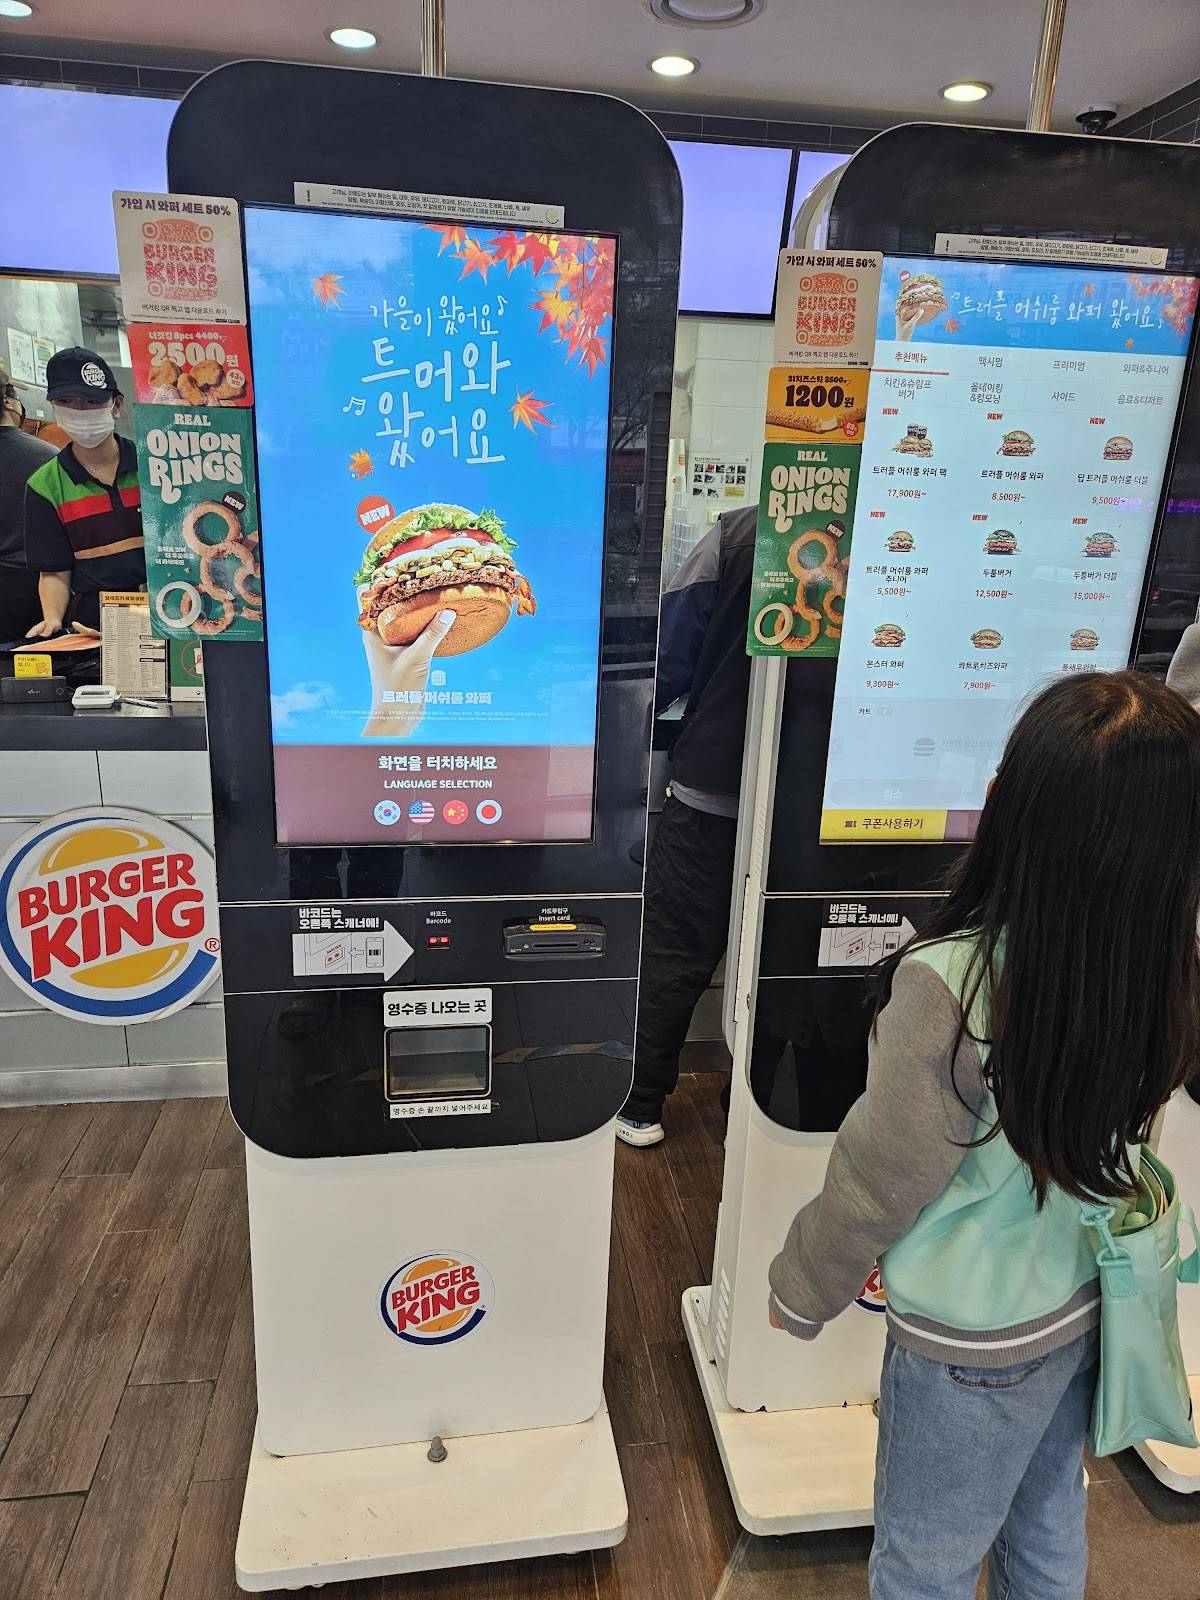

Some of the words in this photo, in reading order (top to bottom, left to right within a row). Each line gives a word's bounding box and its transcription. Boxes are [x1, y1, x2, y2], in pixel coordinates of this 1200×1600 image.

[120, 198, 143, 210] 가입
[145, 199, 157, 211] 시
[158, 200, 180, 213] 와퍼
[182, 202, 204, 214] 세트
[206, 206, 231, 217] 50%
[143, 244, 216, 264] BURGER
[786, 255, 804, 267] 가입
[806, 256, 816, 267] 시
[816, 257, 835, 268] 와퍼
[836, 257, 855, 268] 세트
[855, 258, 877, 268] 50%
[145, 262, 218, 288] KING
[797, 296, 857, 312] BURGER
[958, 289, 1007, 321] 트러플
[1015, 295, 1060, 326] 머쉬룸
[1067, 301, 1101, 321] 와퍼
[1109, 298, 1154, 330] 왔어요
[370, 295, 431, 336] 가을이
[438, 295, 499, 336] 왔어요
[796, 312, 856, 334] KING
[148, 342, 239, 368] 2500원
[895, 351, 928, 363] 추천메뉴
[978, 356, 1003, 368] 맥시멈
[1052, 360, 1086, 372] 프리미엄
[361, 337, 512, 402] 트머와
[1123, 364, 1169, 376] 와퍼&주니어
[884, 377, 932, 389] 치킨&슈림프
[970, 382, 1003, 393] 올데이킹
[785, 384, 855, 408] 1200원
[898, 389, 915, 400] 버거
[970, 393, 1001, 404] &킹모닝
[1051, 391, 1077, 402] 사이드
[1117, 394, 1164, 406] 음료&디저트
[882, 408, 899, 416] NEW
[987, 413, 1003, 421] NEW
[174, 412, 212, 427] REAL
[1089, 417, 1106, 425] NEW
[376, 391, 506, 469] 왔어요
[146, 429, 242, 458] ONION
[796, 450, 828, 462] REAL
[148, 452, 244, 504] RINGS
[872, 466, 896, 476] 트러플
[897, 467, 921, 477] 머쉬룸
[922, 467, 937, 477] 와퍼
[980, 470, 1003, 480] 트러플
[1005, 471, 1027, 481] 머쉬룸
[1029, 472, 1044, 481] 와퍼
[770, 465, 851, 492] ONION
[223, 494, 245, 512] NEW
[768, 485, 849, 533] RINGS
[359, 504, 391, 527] NEW
[1072, 517, 1088, 525] NEW
[826, 522, 844, 538] NEW
[914, 567, 929, 577] 와퍼
[885, 575, 907, 584] 주니어
[866, 660, 888, 669] 몬스터
[890, 660, 905, 669] 와퍼
[382, 690, 422, 704] 트러플
[466, 691, 492, 705] 와퍼
[378, 755, 422, 771] 화면을
[427, 755, 498, 771] 터치하세요
[384, 779, 438, 789] LANGUAGE
[439, 779, 493, 789] SELECTION
[862, 818, 924, 830] 쿠폰사용하기
[18, 853, 197, 929] BURGER
[299, 907, 342, 919] 바코드는
[829, 903, 867, 914] 바코드는
[300, 918, 331, 930] 오른쪽
[334, 917, 380, 929] 스캐너에!
[425, 917, 452, 925] Barcode
[538, 914, 556, 922] Insert
[828, 913, 857, 924] 오른쪽
[858, 913, 899, 924] 스캐너에!
[30, 888, 205, 980] KING
[388, 1001, 428, 1016] 영수증
[431, 1000, 471, 1014] 나오는
[474, 999, 487, 1013] 곳
[393, 1107, 416, 1116] 영수증
[451, 1103, 488, 1113] 넣어주세요
[391, 1265, 476, 1310] BURGER
[397, 1281, 480, 1333] KING
